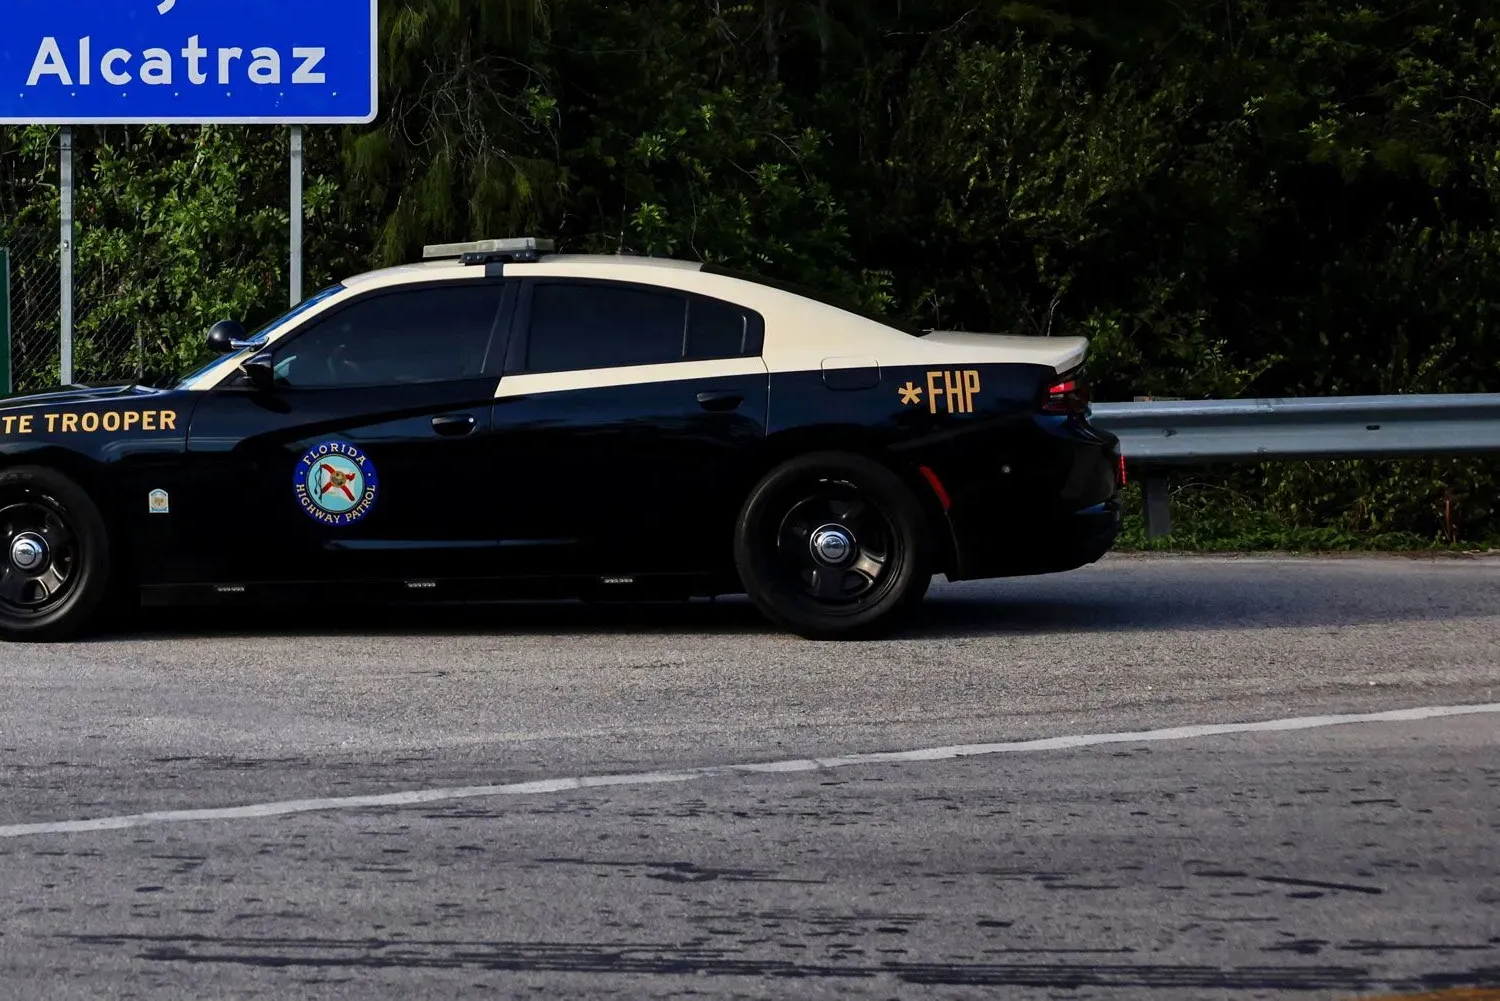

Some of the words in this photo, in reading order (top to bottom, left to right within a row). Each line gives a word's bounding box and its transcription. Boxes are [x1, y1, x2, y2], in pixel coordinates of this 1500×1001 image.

[25, 34, 326, 86] Alcatraz
[44, 410, 177, 433] TROOPER
[303, 443, 367, 466] FLORIDA
[296, 483, 340, 523] HIGHWAY
[345, 484, 376, 522] PATROL
